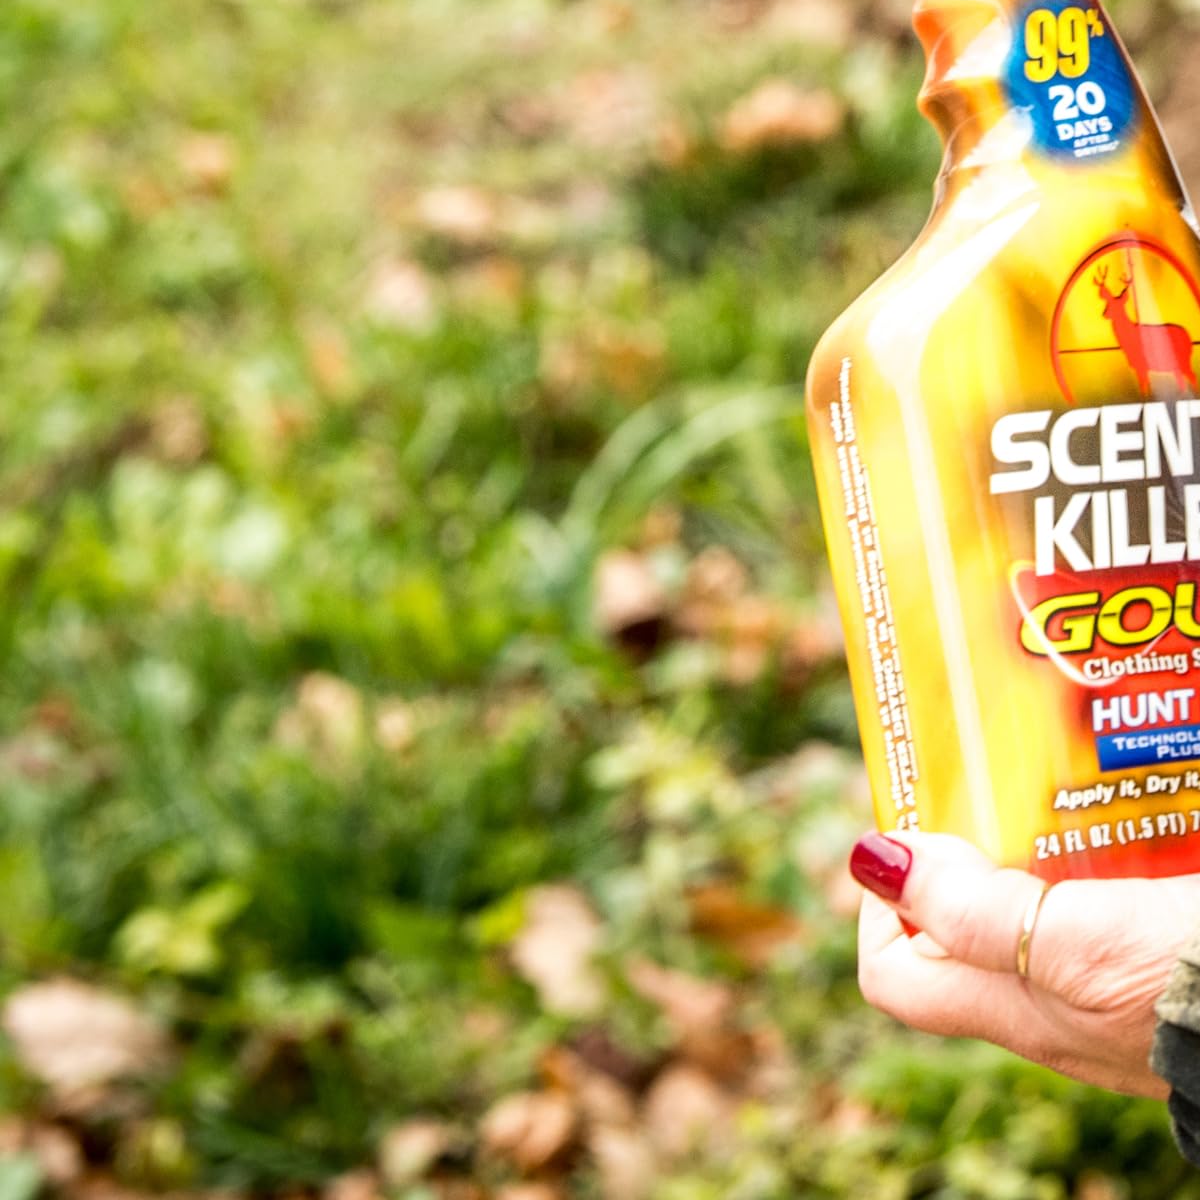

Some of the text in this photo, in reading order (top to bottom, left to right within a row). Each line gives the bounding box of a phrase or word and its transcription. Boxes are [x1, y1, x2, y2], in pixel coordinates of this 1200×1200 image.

[1024, 7, 1104, 83] 99%
[1048, 81, 1106, 121] 20
[1056, 116, 1113, 141] DAYS
[1083, 650, 1189, 681] Clothing
[1092, 687, 1195, 732] HUNT
[1054, 781, 1115, 810] Apply
[1120, 778, 1142, 799] it,
[1146, 774, 1180, 795] Dry
[1034, 834, 1060, 860] 24
[1064, 830, 1086, 853] FL
[1089, 824, 1113, 849] OZ
[1116, 816, 1154, 845] (1.5
[1158, 811, 1187, 836] PT)
